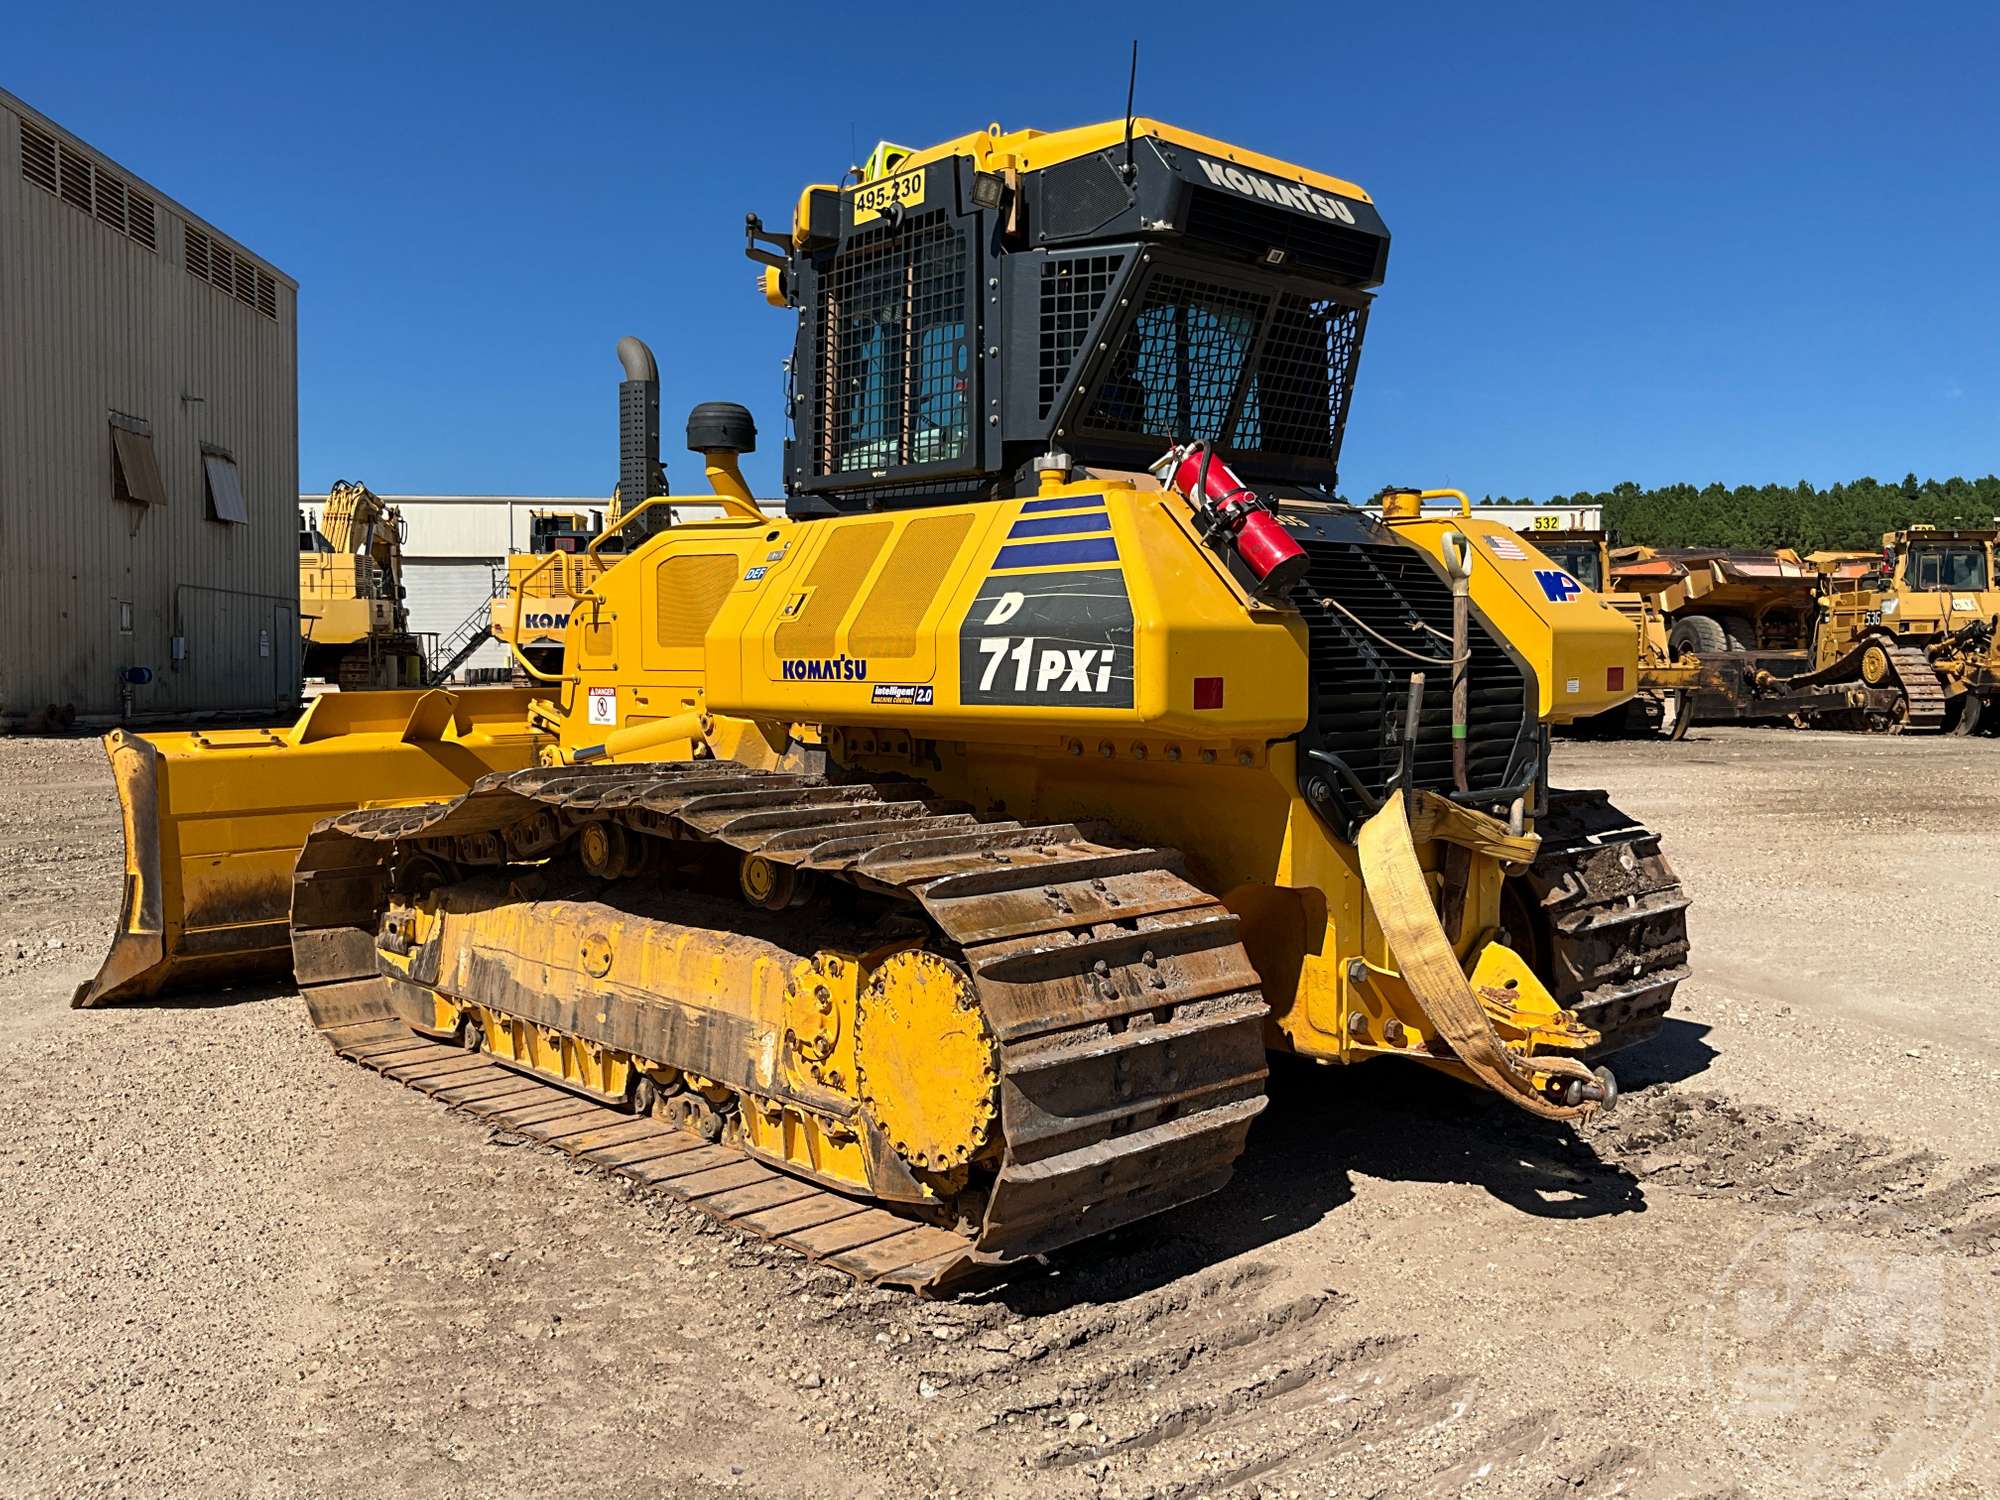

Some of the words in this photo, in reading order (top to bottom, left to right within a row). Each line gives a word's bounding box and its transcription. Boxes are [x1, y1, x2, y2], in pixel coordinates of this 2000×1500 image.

[856, 174, 921, 212] 495-230
[1197, 158, 1356, 225] KOMATSU
[1535, 516, 1559, 530] 532
[745, 567, 767, 580] DEF
[983, 592, 1025, 626] D
[782, 653, 867, 681] KOMATSU
[979, 637, 1115, 693] 71PXi
[594, 687, 615, 696] DANGER
[874, 686, 915, 698] intelligent
[916, 688, 932, 703] 2.0
